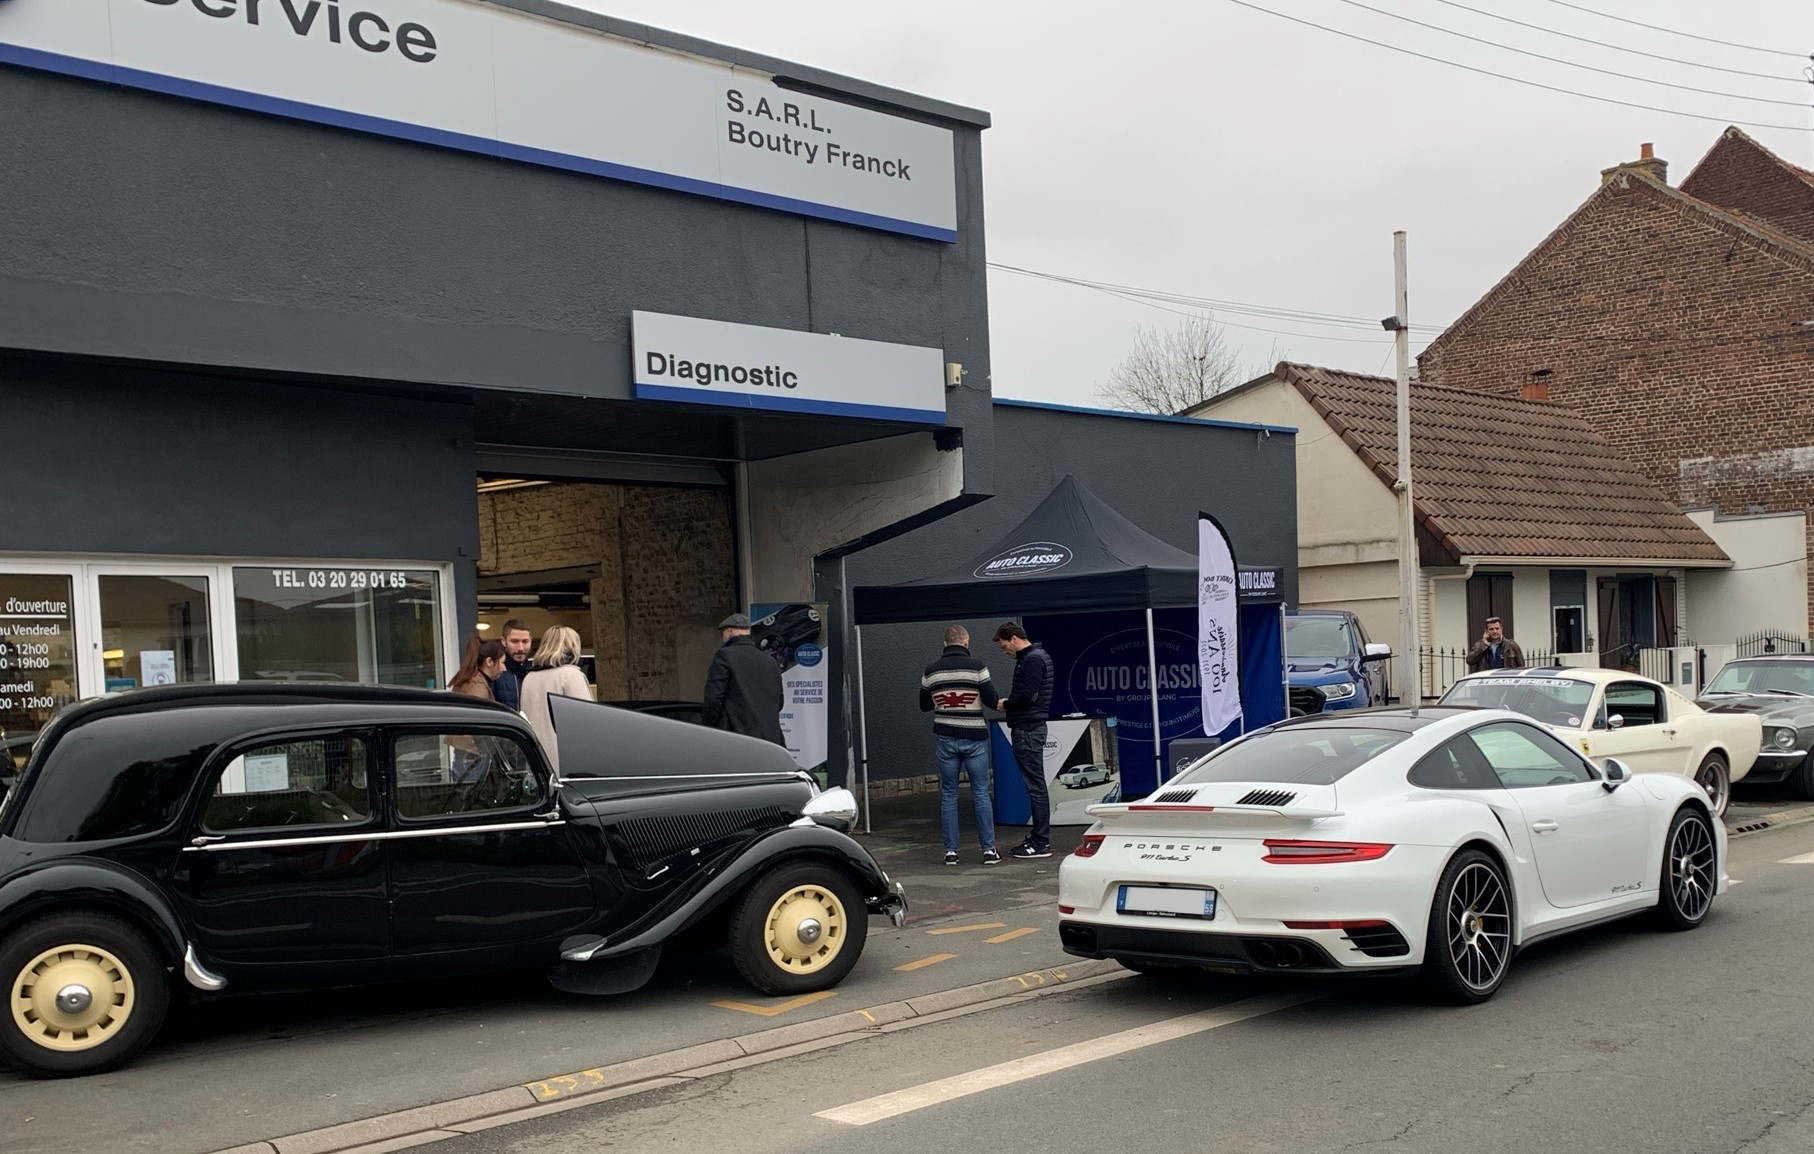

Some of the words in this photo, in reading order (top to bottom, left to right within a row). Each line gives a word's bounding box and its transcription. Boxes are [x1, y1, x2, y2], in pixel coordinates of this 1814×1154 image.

[726, 89, 832, 133] S.A.R.L.
[728, 119, 819, 164] Boutry
[827, 142, 912, 181] Franck
[646, 351, 798, 389] Diagnostic
[985, 558, 1018, 570] AUTO
[1015, 553, 1064, 565] CLASSIC
[272, 570, 305, 588] TEL.
[309, 571, 326, 588] 03
[330, 571, 347, 588] 20
[350, 571, 367, 588] 29
[370, 571, 385, 588] 01
[390, 571, 406, 588] 65
[1239, 572, 1253, 589] AUTO
[1253, 571, 1276, 589] CLASSIC
[12, 624, 60, 636] Vendredi
[16, 643, 49, 655] 12h00
[17, 657, 49, 669] 19h00
[1085, 665, 1131, 690] AUTO
[0, 680, 34, 693] amedi
[21, 696, 54, 708] 12h00
[1157, 693, 1177, 701] LANG
[1124, 843, 1222, 851] PORSCHE
[1178, 854, 1192, 862] S
[1204, 903, 1214, 914] 59
